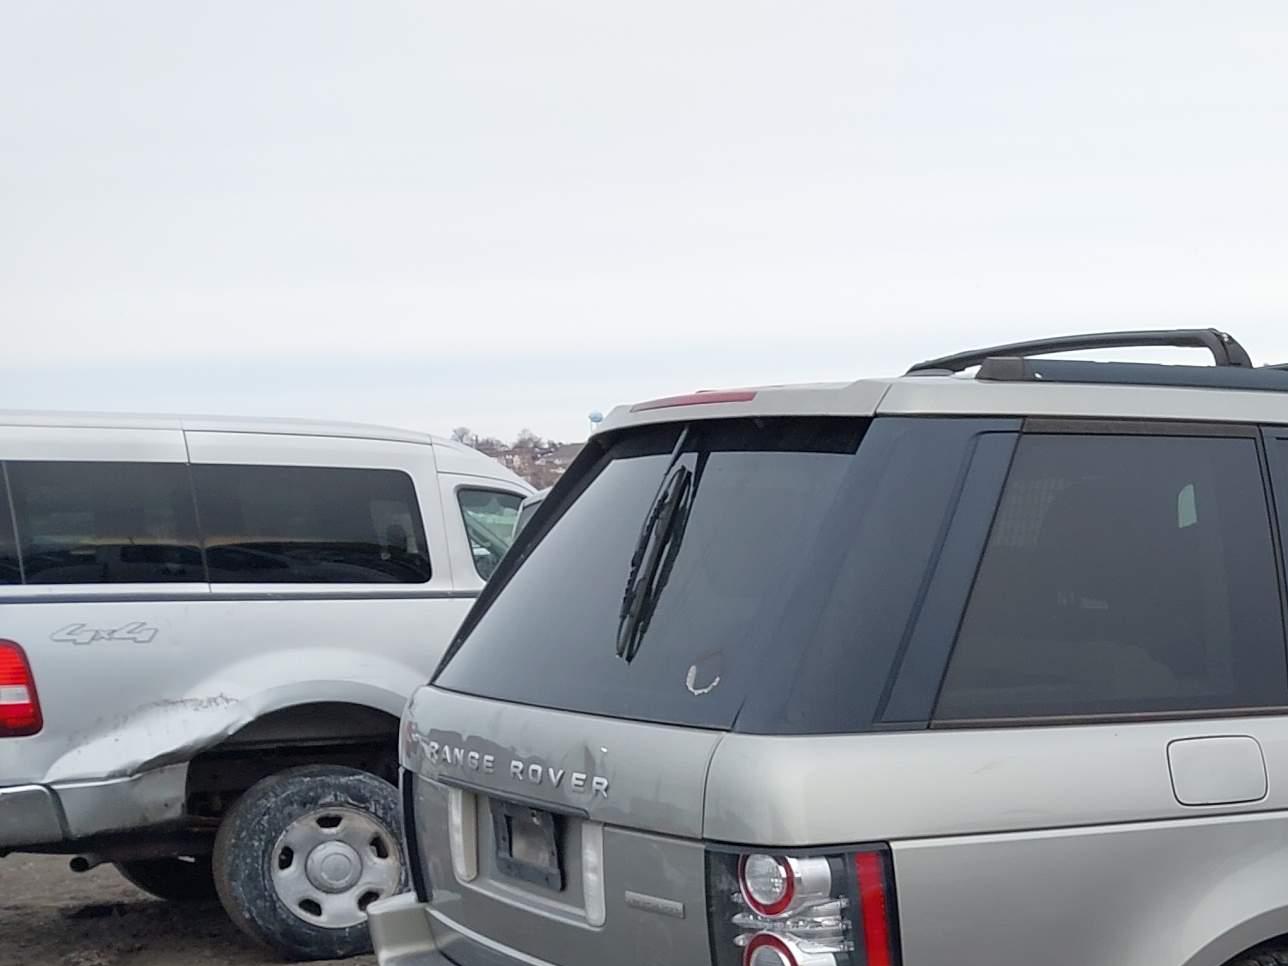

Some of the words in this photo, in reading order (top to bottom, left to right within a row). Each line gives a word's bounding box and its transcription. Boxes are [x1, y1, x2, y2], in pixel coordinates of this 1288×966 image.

[49, 621, 159, 646] 4x4
[426, 740, 496, 774] RANGE
[510, 759, 610, 799] ROVER
